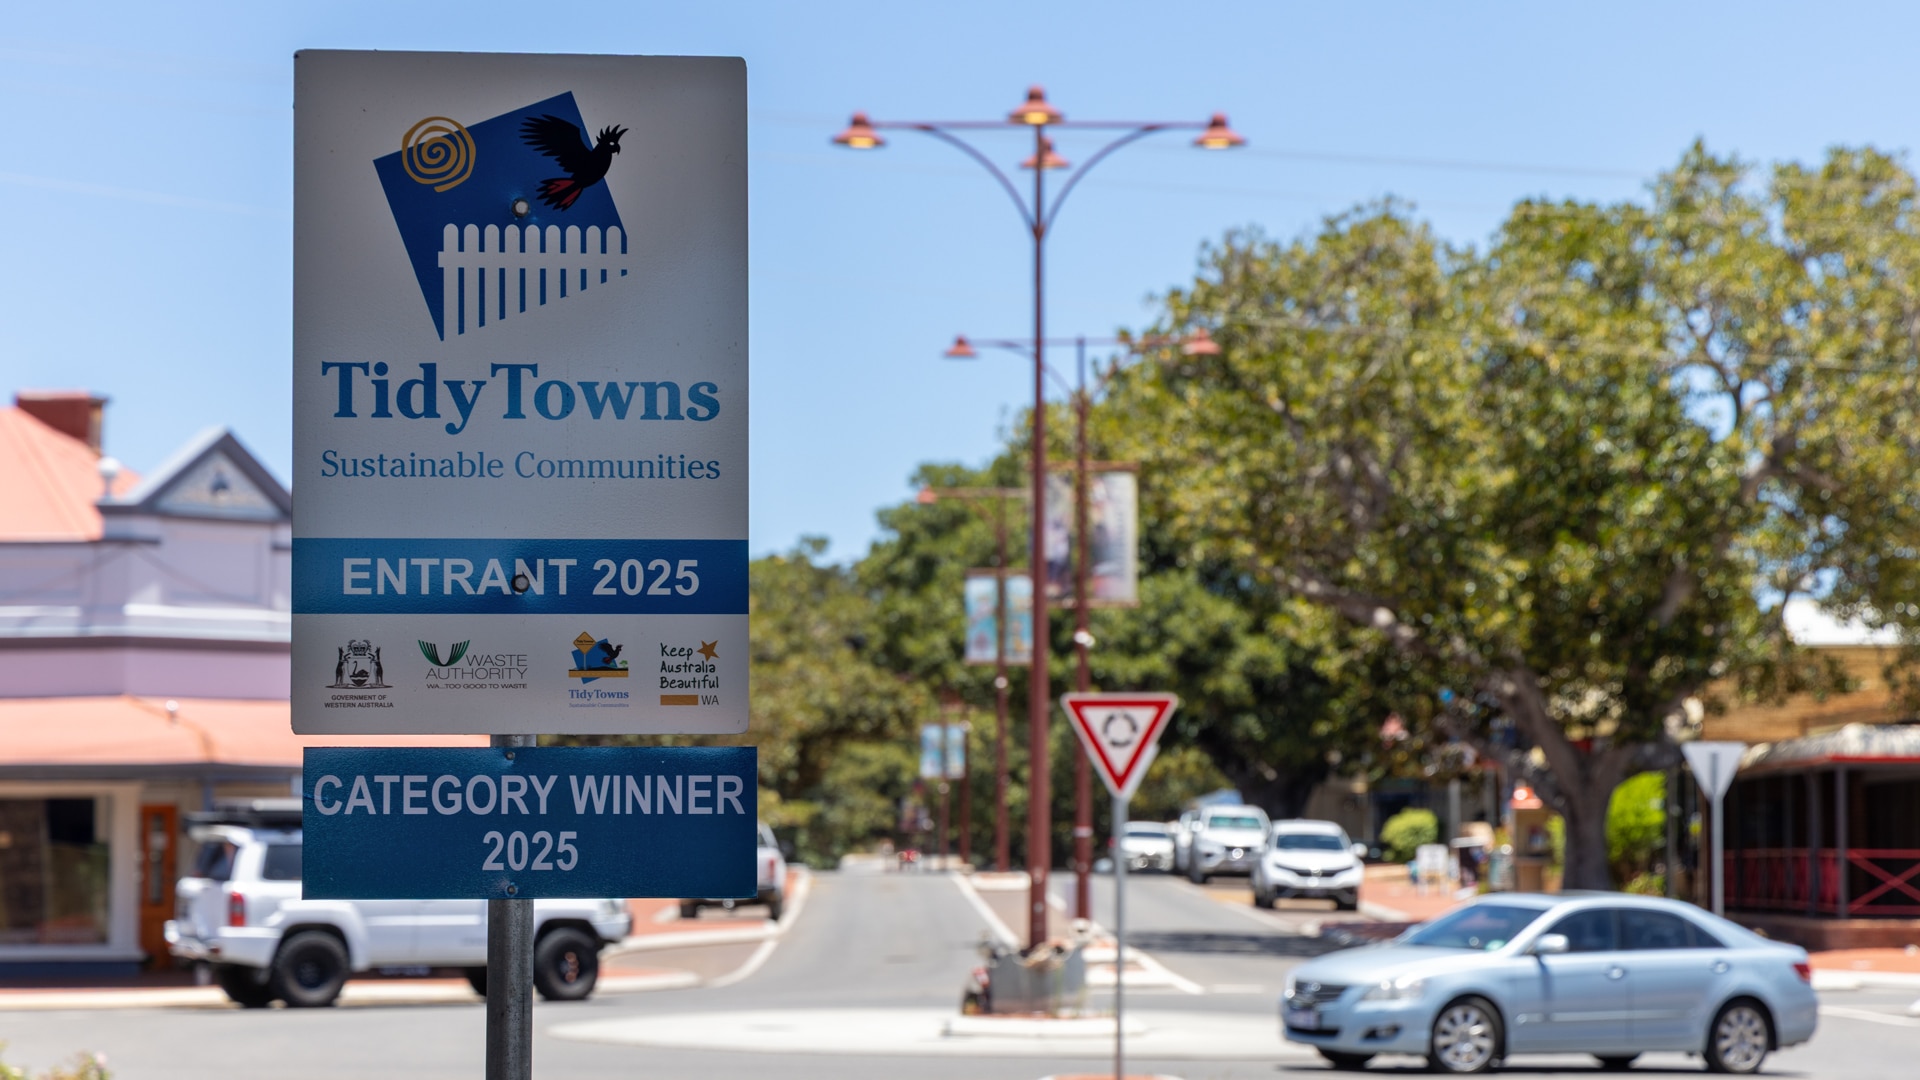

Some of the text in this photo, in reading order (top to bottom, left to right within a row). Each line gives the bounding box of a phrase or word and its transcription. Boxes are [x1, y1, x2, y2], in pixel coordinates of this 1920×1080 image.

[321, 360, 721, 435] TidyTowns
[321, 449, 721, 480] Sustainable Communities
[343, 557, 700, 597] ENTRANT 2025
[660, 642, 693, 661] Keep
[465, 654, 528, 667] WASTE
[660, 660, 716, 673] Australia
[425, 667, 528, 680] AUTHORITY
[660, 675, 719, 689] Beautiful
[568, 689, 629, 701] TidyTowns
[701, 695, 720, 706] WA
[313, 774, 746, 816] CATEGORY WINNER
[481, 830, 579, 872] 2025
